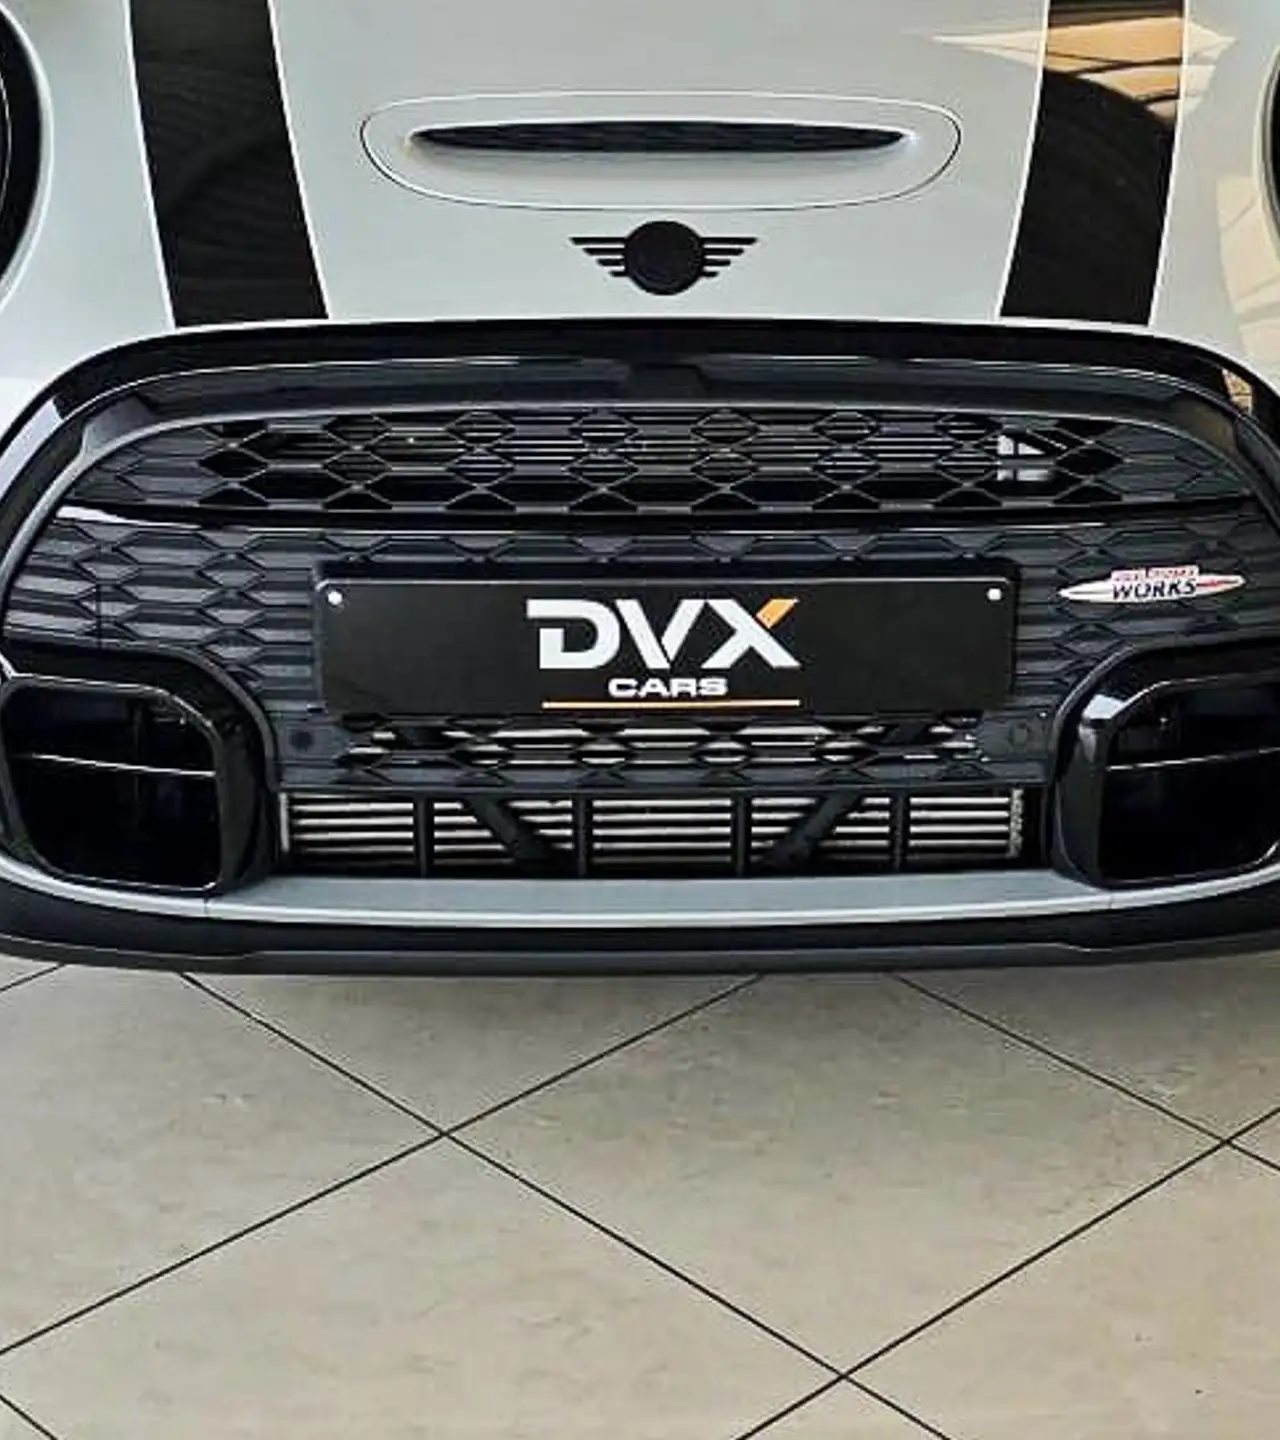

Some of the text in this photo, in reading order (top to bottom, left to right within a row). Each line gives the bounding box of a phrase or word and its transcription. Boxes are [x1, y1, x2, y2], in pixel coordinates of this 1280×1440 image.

[1113, 578, 1197, 600] WORKS
[526, 598, 801, 669] DVX
[608, 677, 728, 697] CARS
